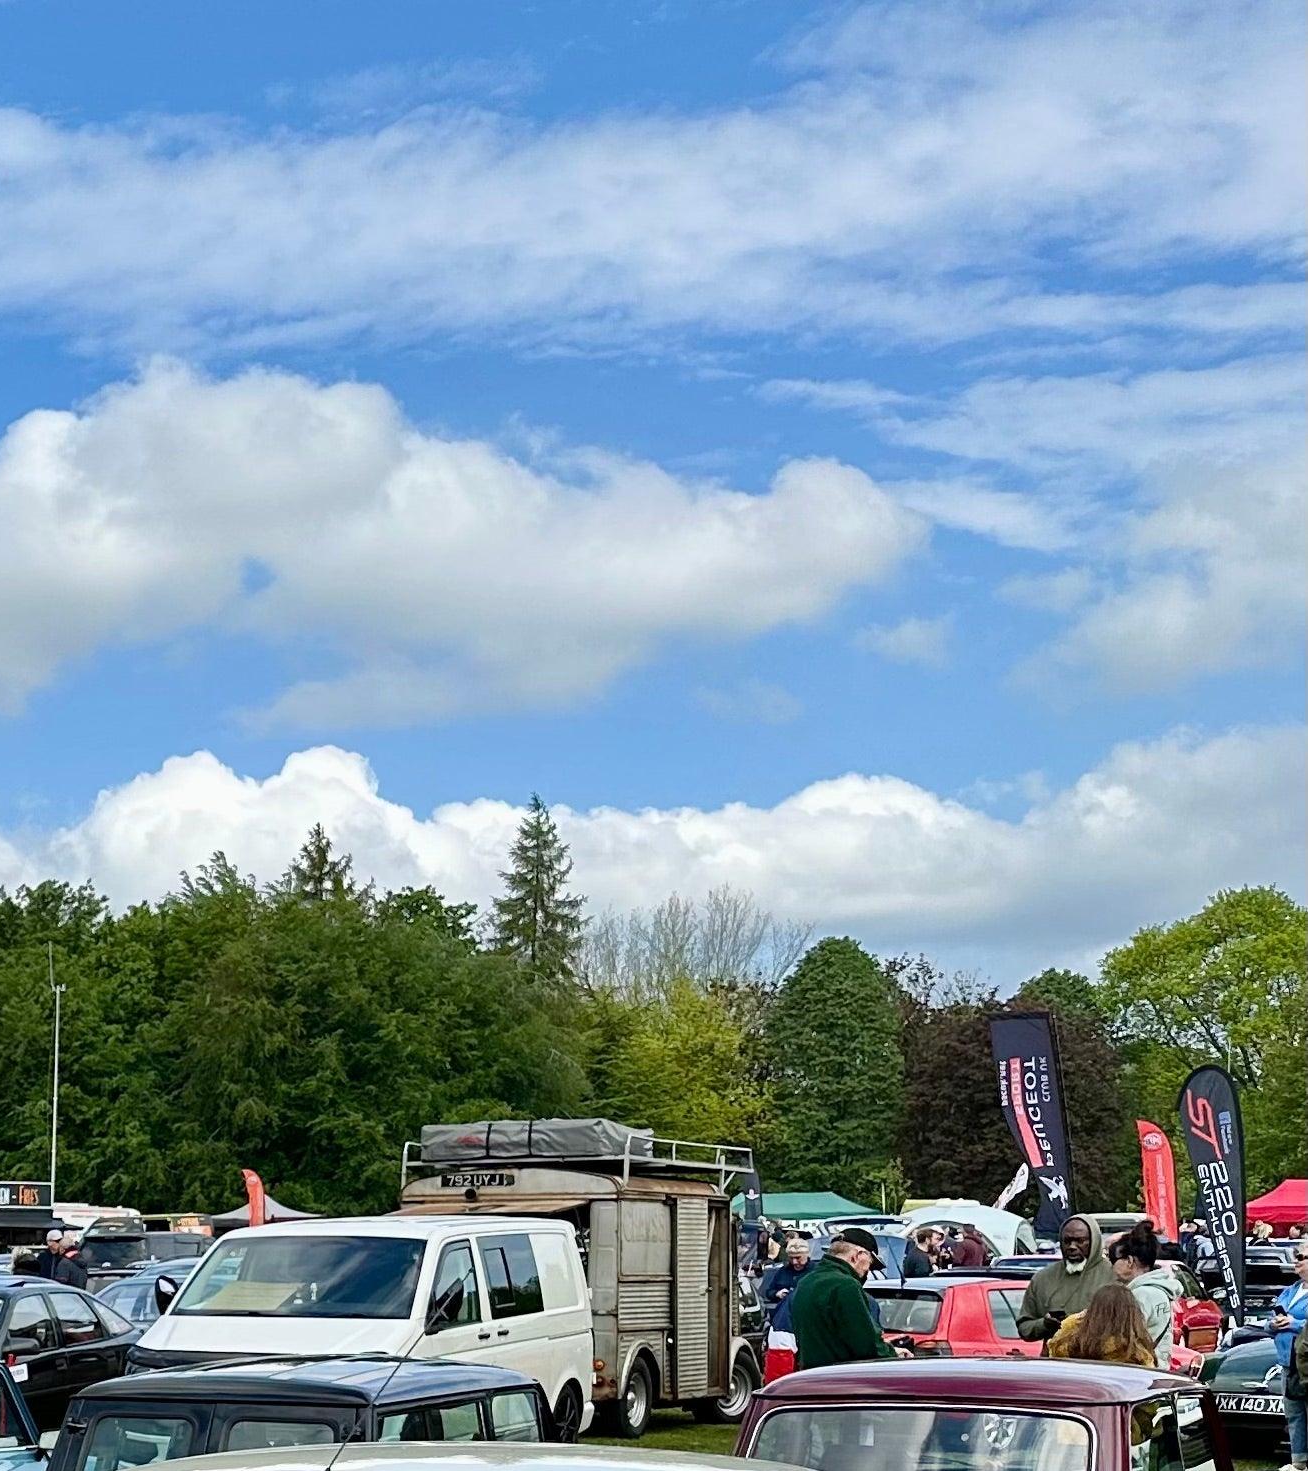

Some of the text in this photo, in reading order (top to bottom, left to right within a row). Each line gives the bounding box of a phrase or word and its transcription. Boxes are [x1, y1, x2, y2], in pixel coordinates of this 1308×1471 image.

[446, 1174, 500, 1187] 792 UYJ
[1208, 1159, 1238, 1236] 220
[1196, 1163, 1241, 1309] ENTHUSIASTS
[1218, 1397, 1238, 1410] XK
[1240, 1398, 1265, 1412] 140
